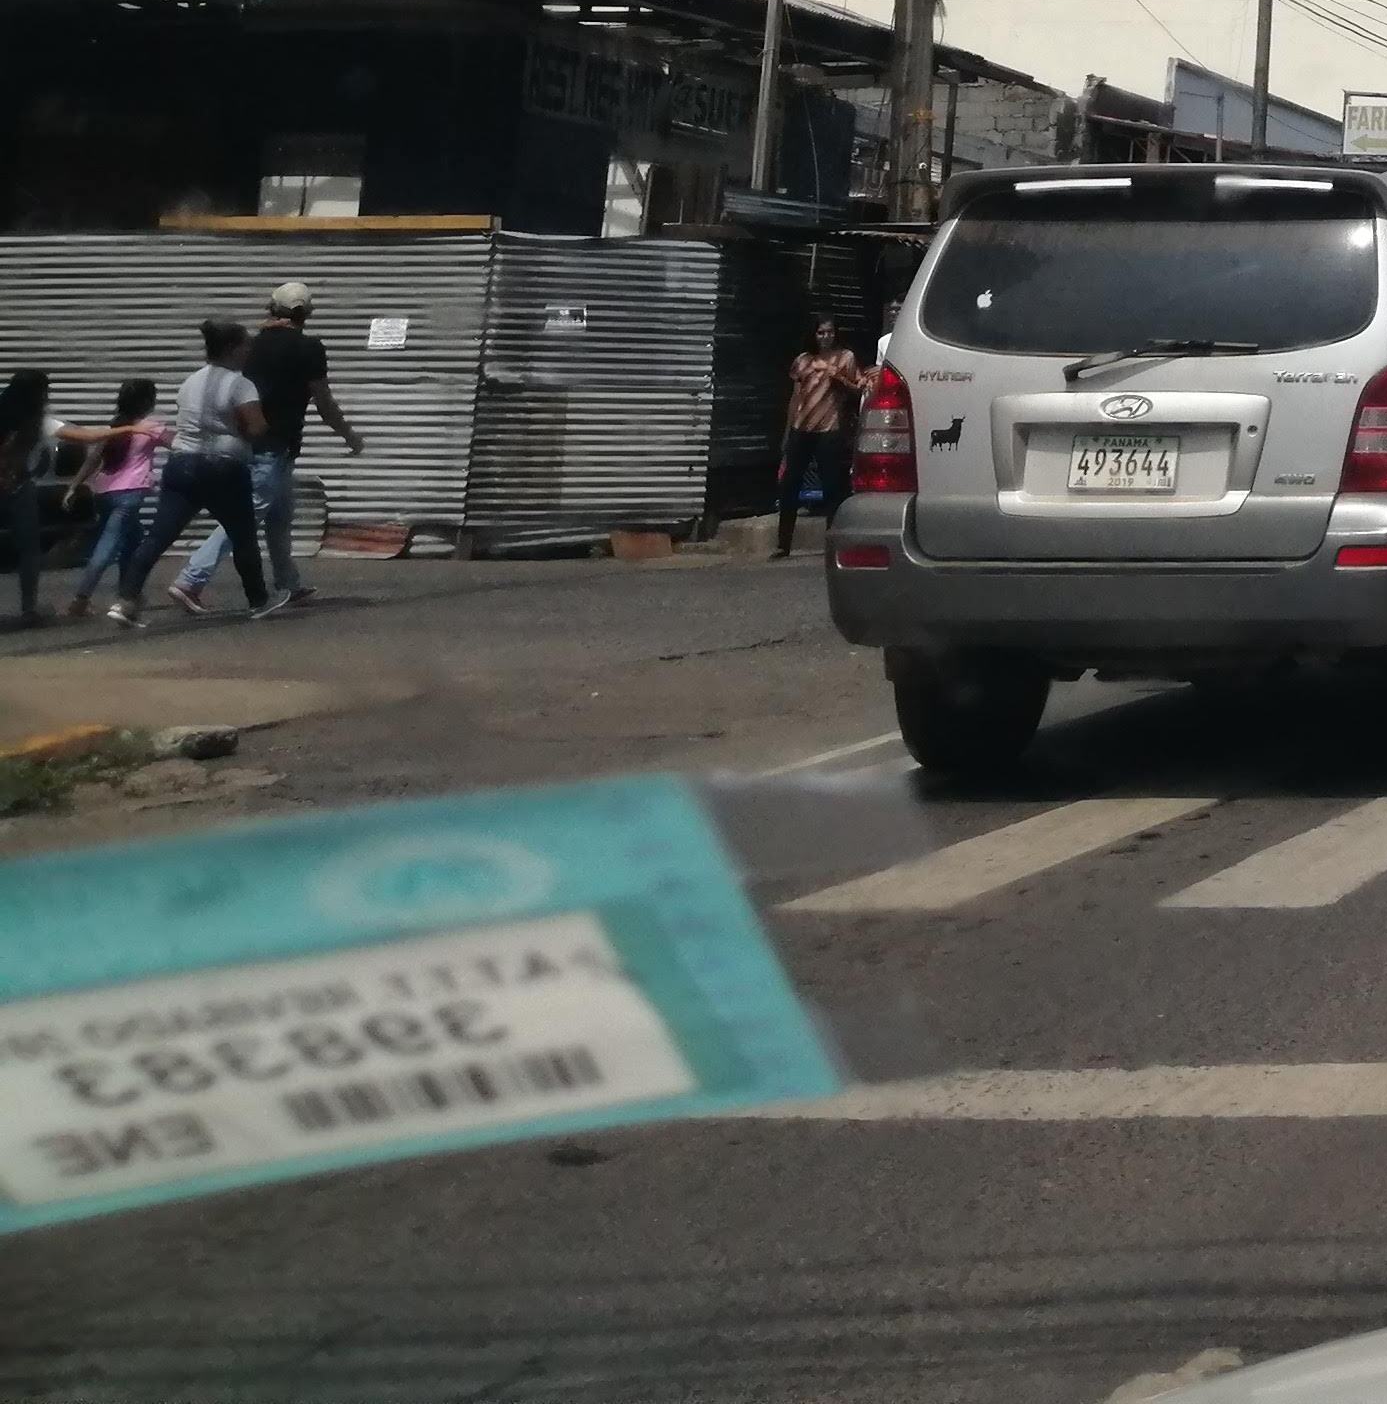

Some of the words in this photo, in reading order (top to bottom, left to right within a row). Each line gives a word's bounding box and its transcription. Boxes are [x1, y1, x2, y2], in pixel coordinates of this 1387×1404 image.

[1103, 438, 1149, 447] PANAMA
[1077, 448, 1169, 477] 493644
[1107, 477, 1135, 487] 2019
